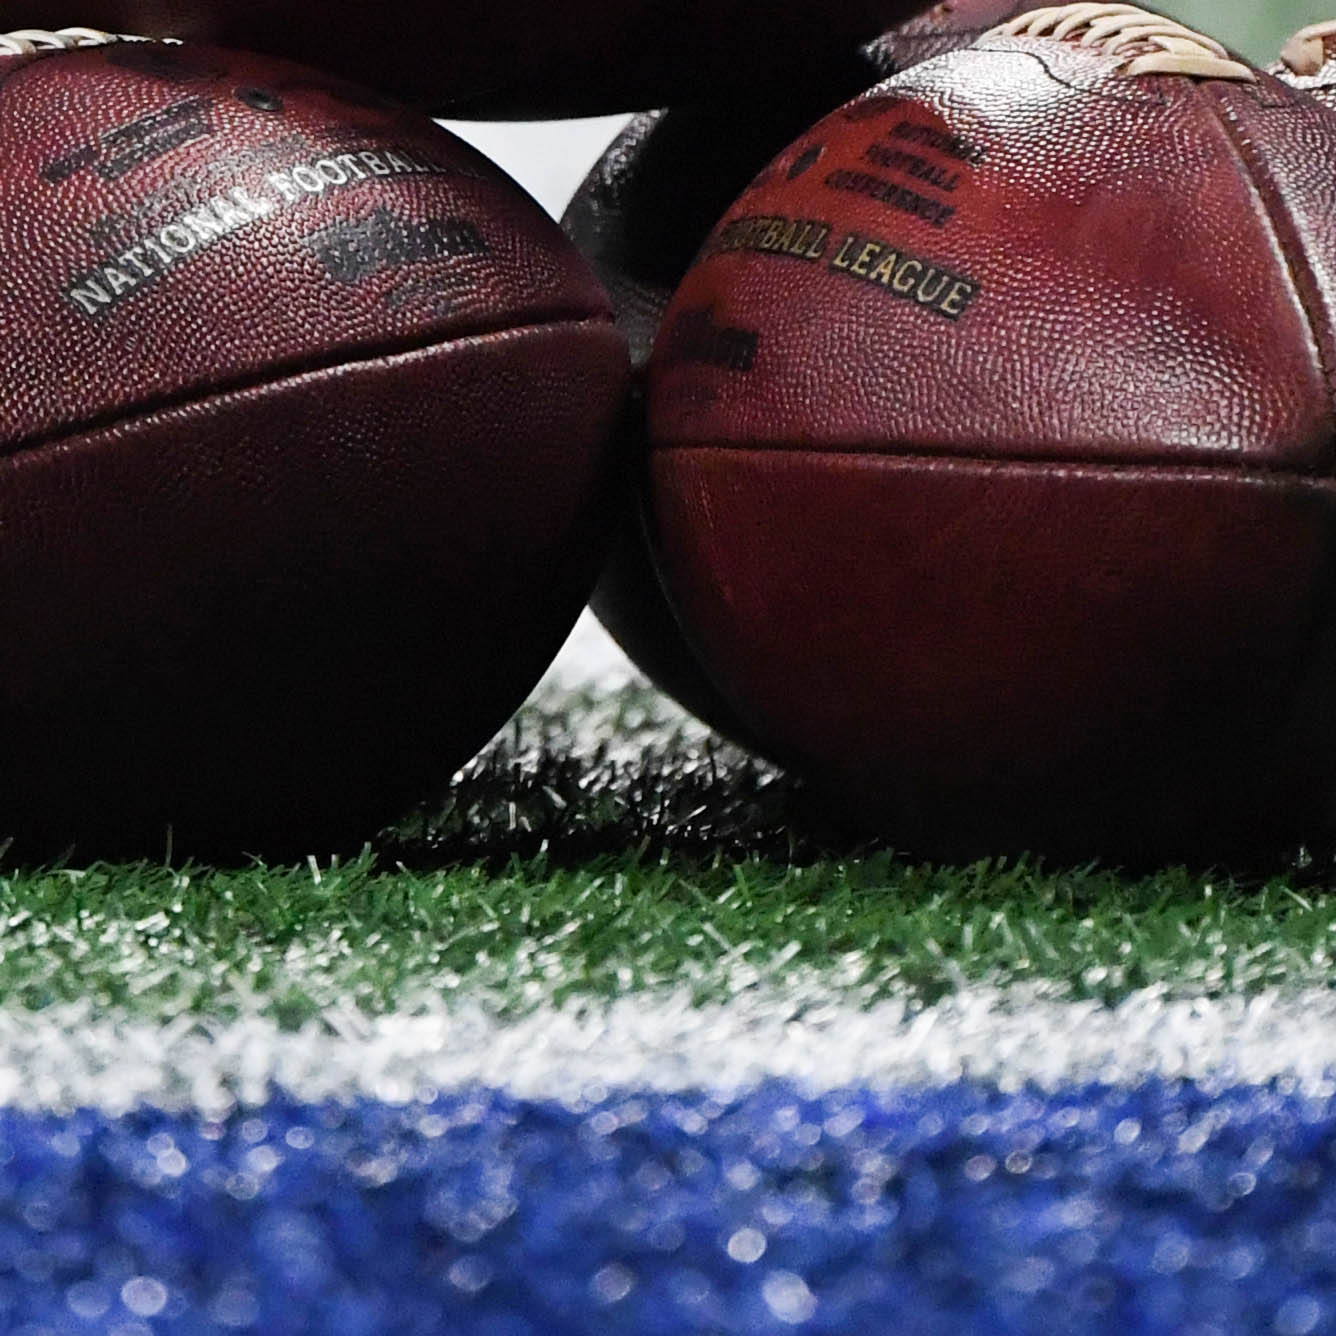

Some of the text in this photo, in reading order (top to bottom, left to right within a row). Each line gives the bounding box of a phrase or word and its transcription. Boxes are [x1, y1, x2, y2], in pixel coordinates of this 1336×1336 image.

[68, 189, 274, 316] NATIONAL
[270, 148, 447, 201] FOOTBALL
[832, 235, 976, 318] LEAGUE
